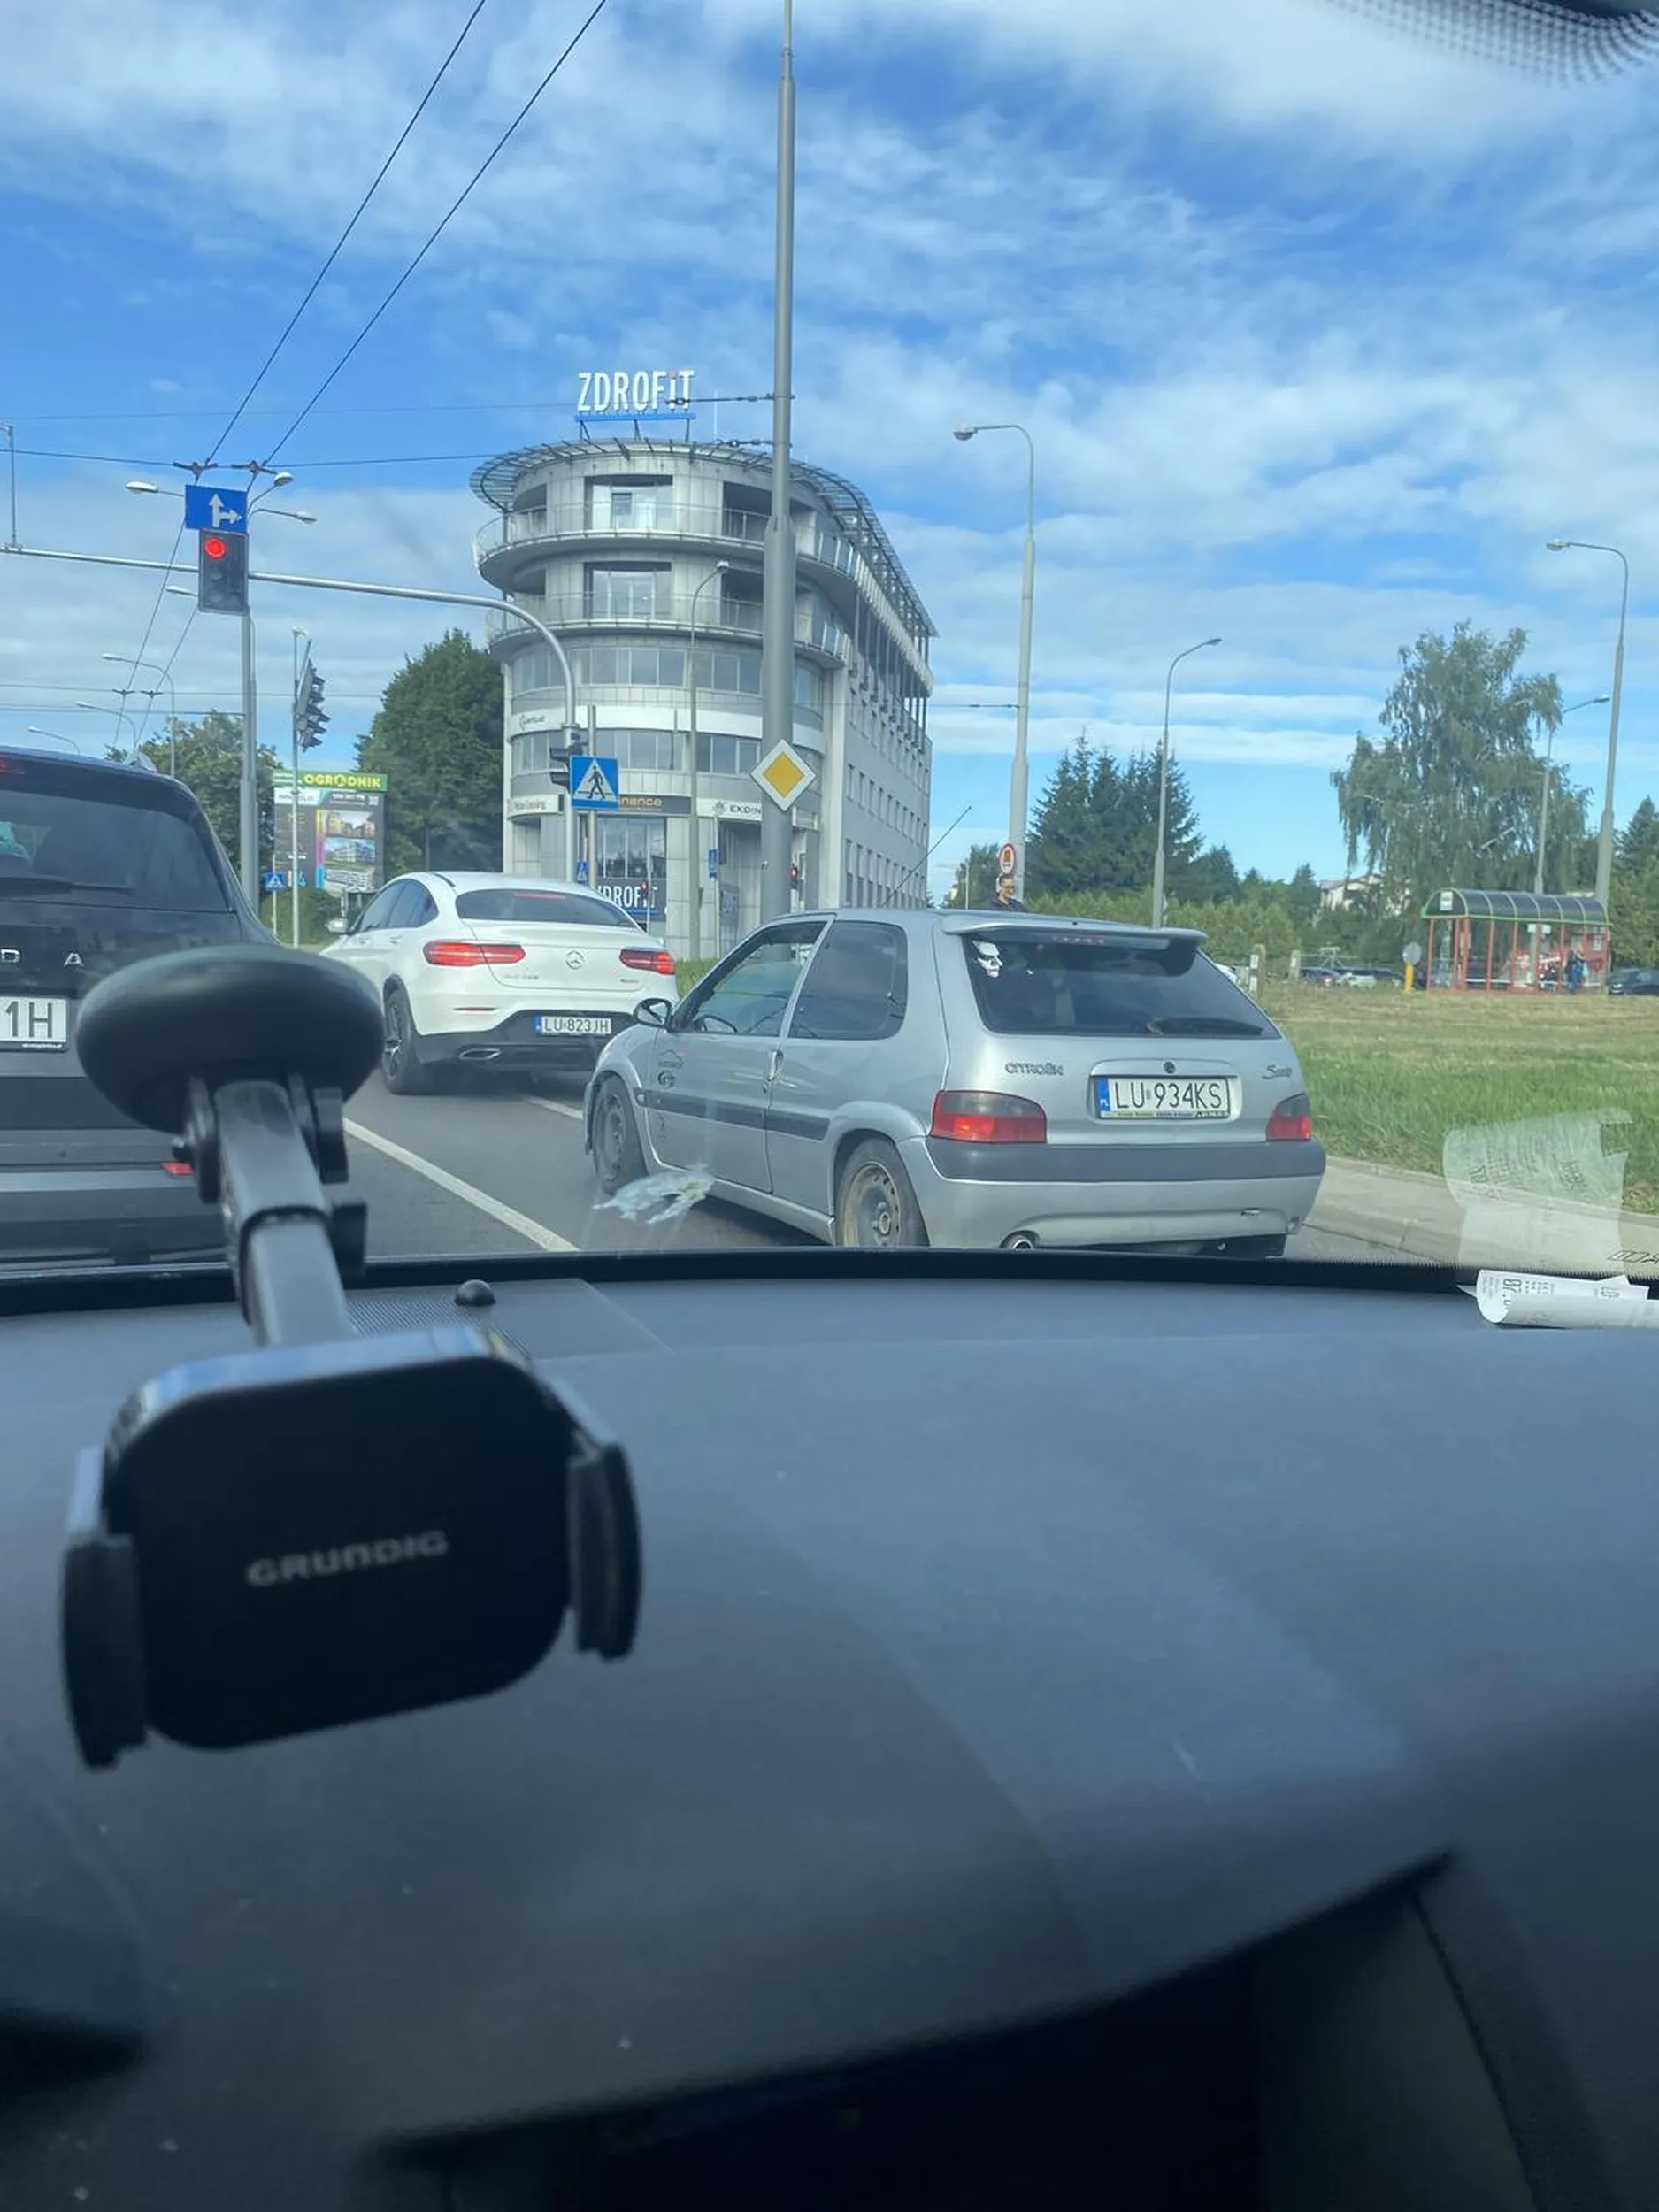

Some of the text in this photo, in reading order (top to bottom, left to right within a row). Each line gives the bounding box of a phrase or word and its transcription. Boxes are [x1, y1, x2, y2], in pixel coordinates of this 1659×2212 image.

[619, 797, 663, 807] nance
[1115, 1082, 1223, 1109] LU 934KS
